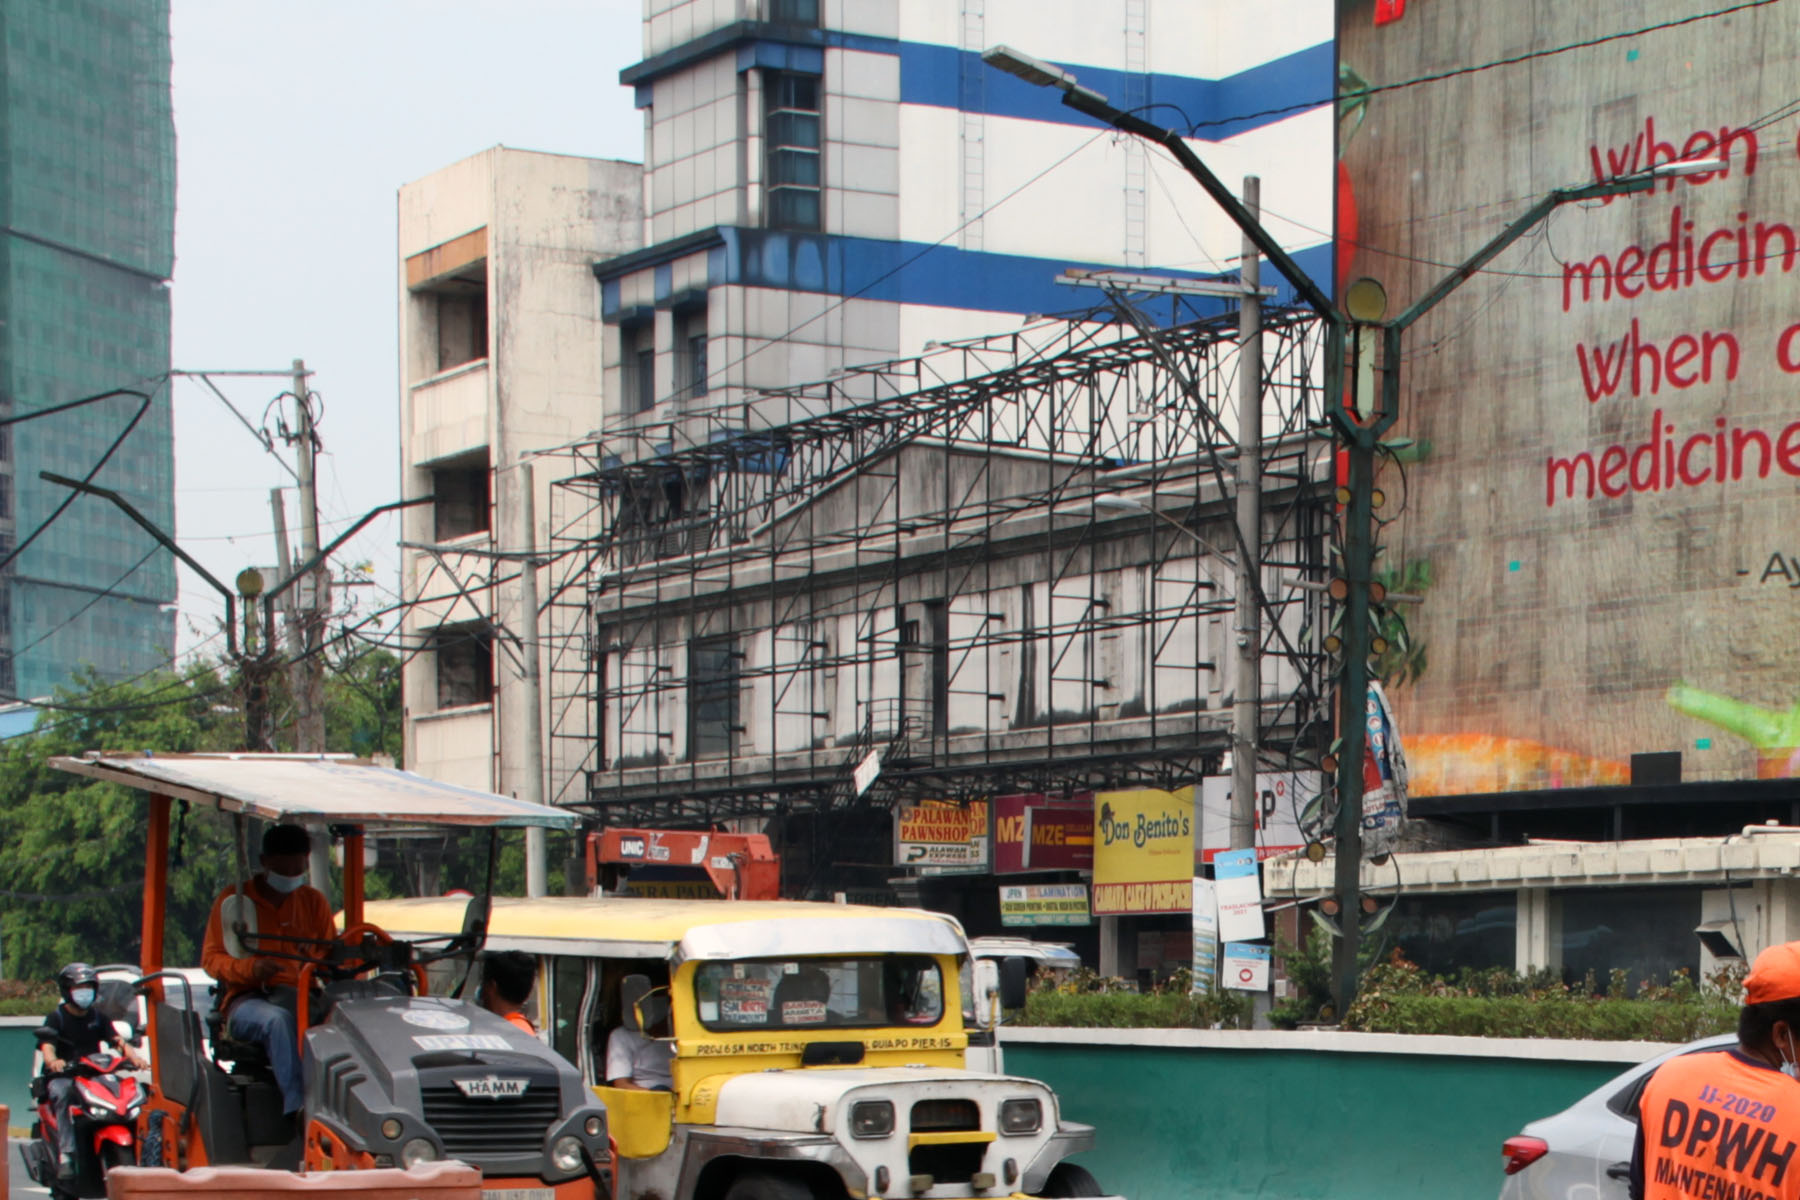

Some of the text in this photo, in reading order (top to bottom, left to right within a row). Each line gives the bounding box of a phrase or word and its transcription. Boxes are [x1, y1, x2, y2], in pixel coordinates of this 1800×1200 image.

[913, 808, 968, 825] PALAWAN
[902, 826, 969, 841] PAWNSHOP
[1032, 825, 1064, 845] MZE
[1100, 811, 1190, 848] Don Benito's
[621, 840, 645, 856] UNIC
[1040, 887, 1085, 897] LAMINATION
[747, 1043, 777, 1053] NORTH
[872, 1039, 908, 1050] QUIAPO
[469, 1081, 519, 1094] HAMM
[1698, 1085, 1776, 1123] JJ-2020
[1660, 1099, 1797, 1187] DPWH
